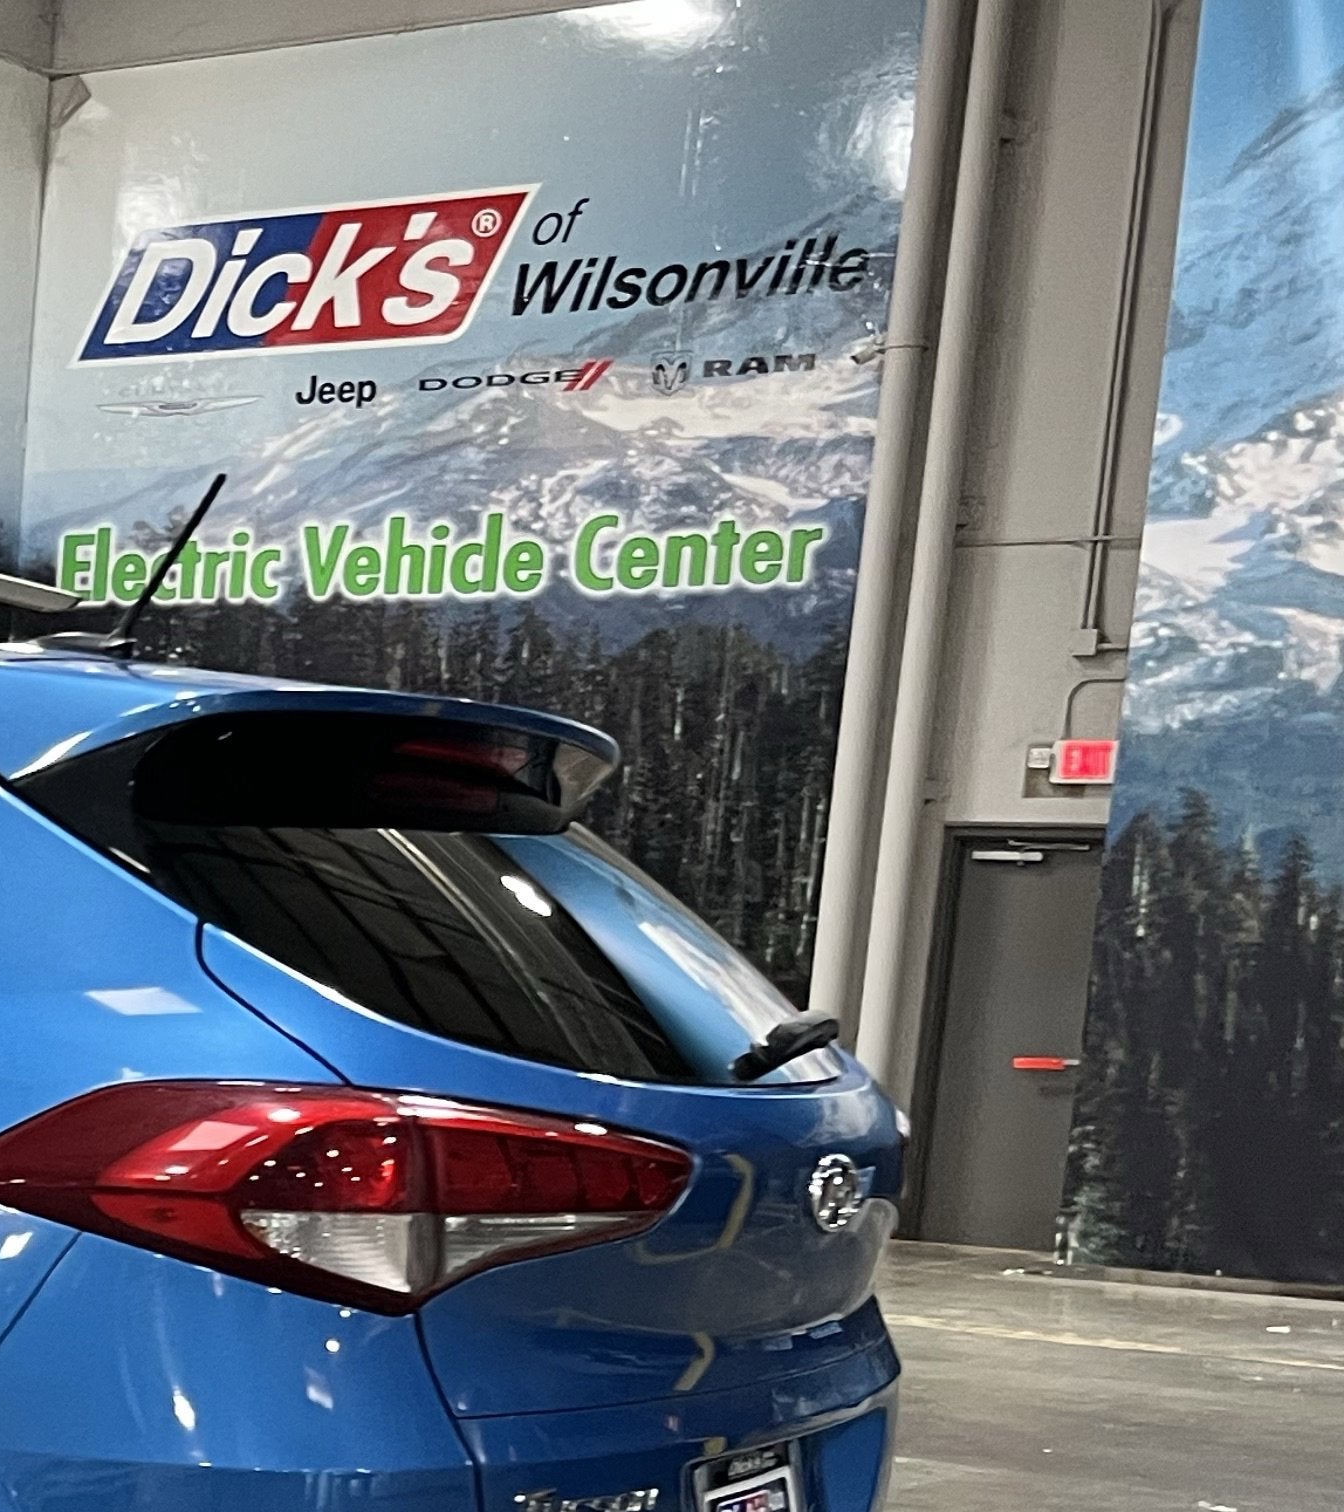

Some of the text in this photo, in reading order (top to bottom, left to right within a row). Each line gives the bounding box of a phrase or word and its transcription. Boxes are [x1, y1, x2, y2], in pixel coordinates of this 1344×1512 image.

[532, 197, 590, 246] of
[511, 231, 871, 316] Wilsonville
[295, 353, 816, 408] Jeep DODGE RAM
[60, 512, 824, 602] Electric Vehicle Center
